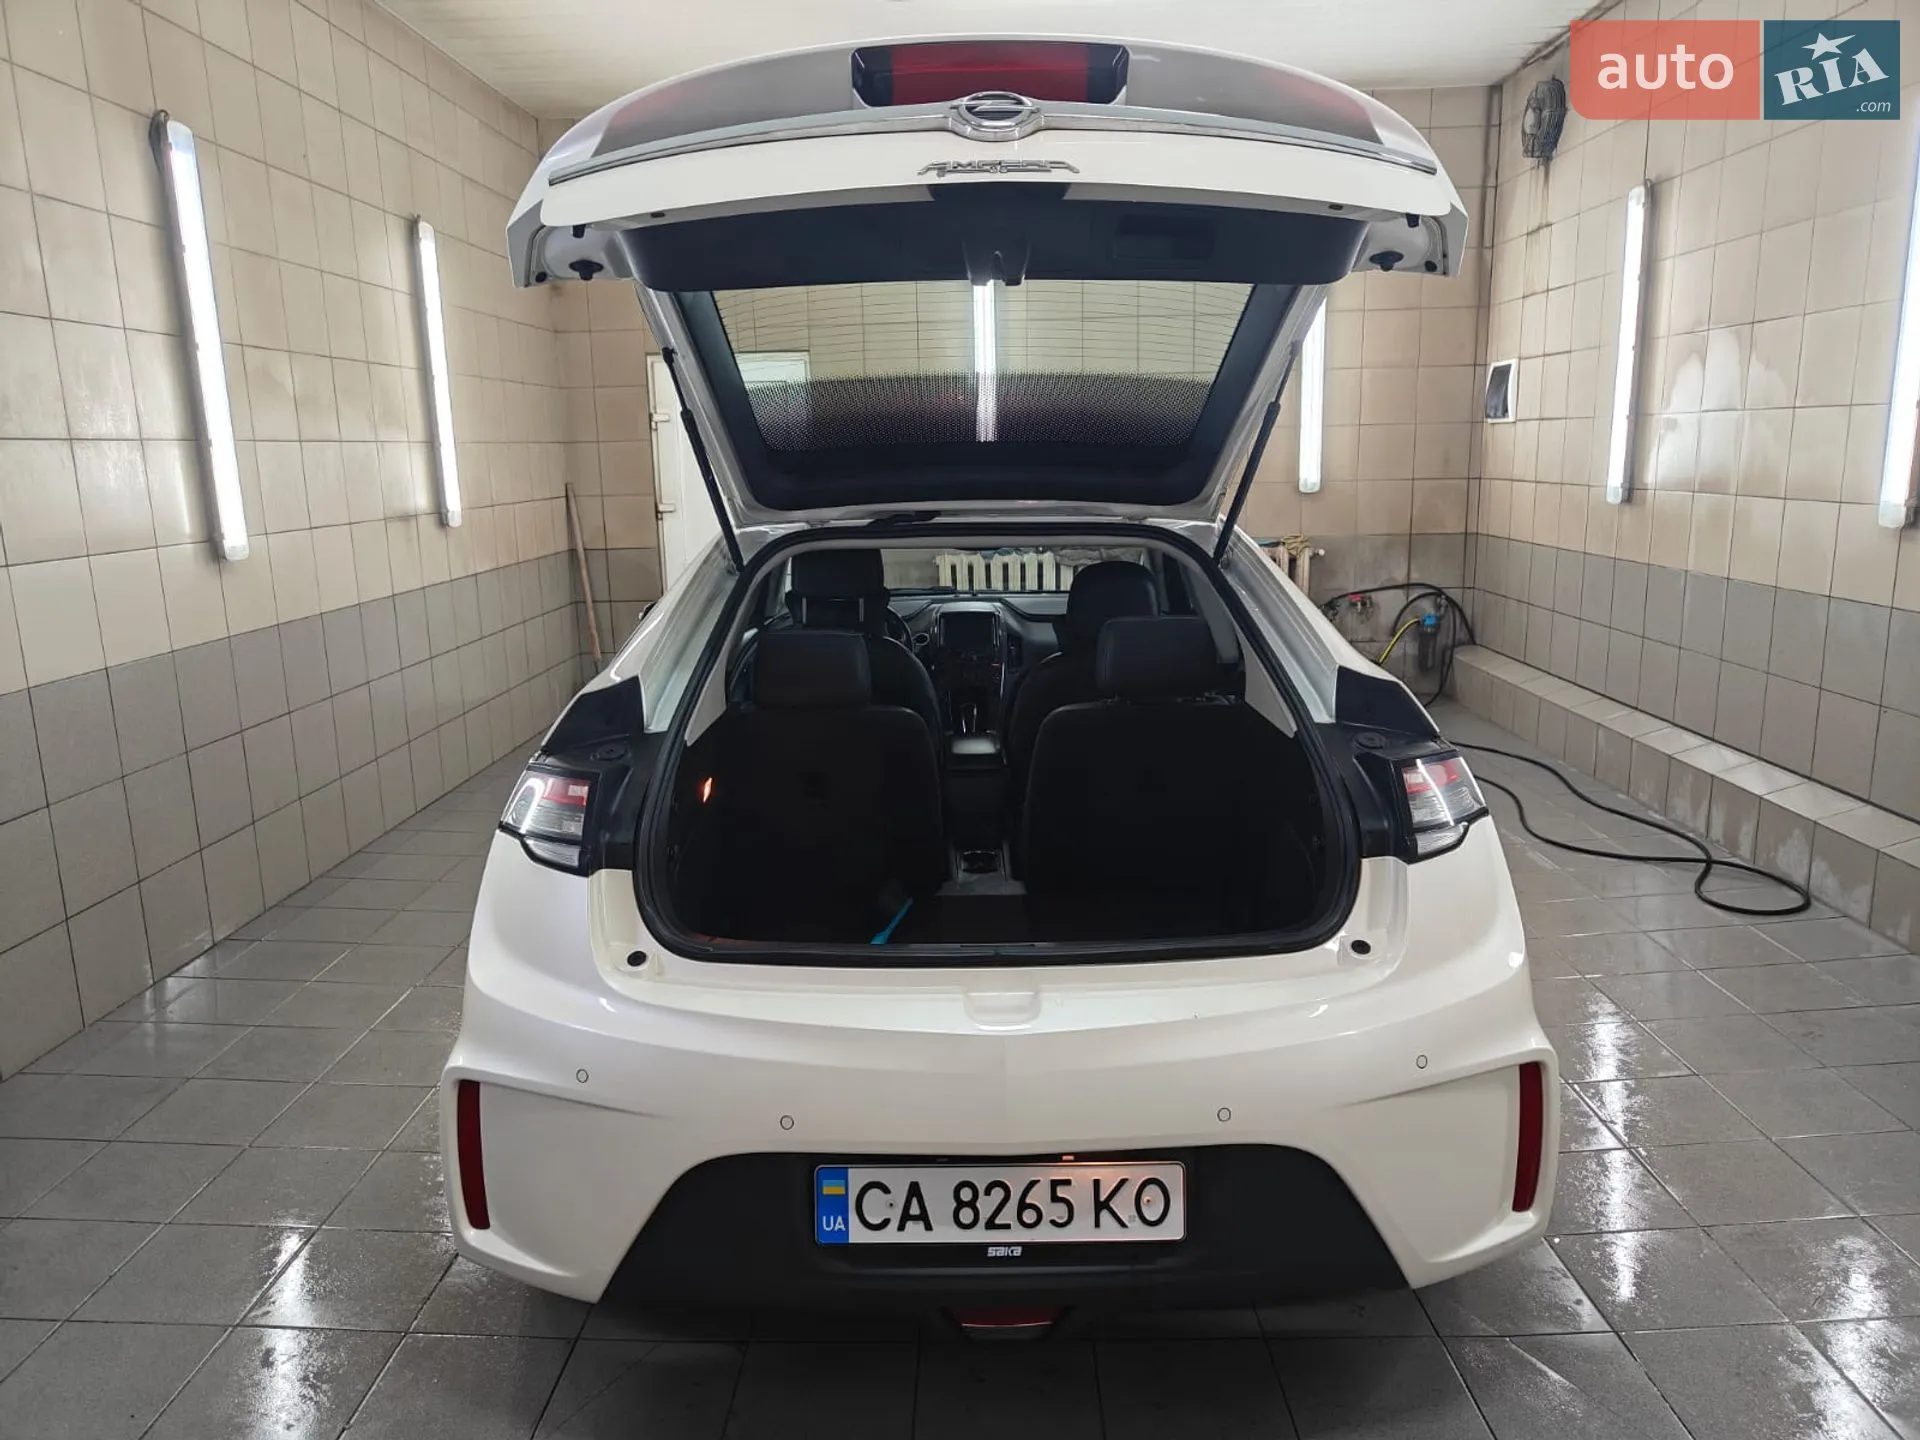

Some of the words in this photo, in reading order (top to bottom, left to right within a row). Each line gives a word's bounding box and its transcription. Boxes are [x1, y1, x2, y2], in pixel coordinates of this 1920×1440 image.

[855, 1180, 933, 1232] CA
[952, 1178, 1075, 1231] 8265
[1093, 1177, 1171, 1229] KO
[822, 1215, 846, 1232] UA
